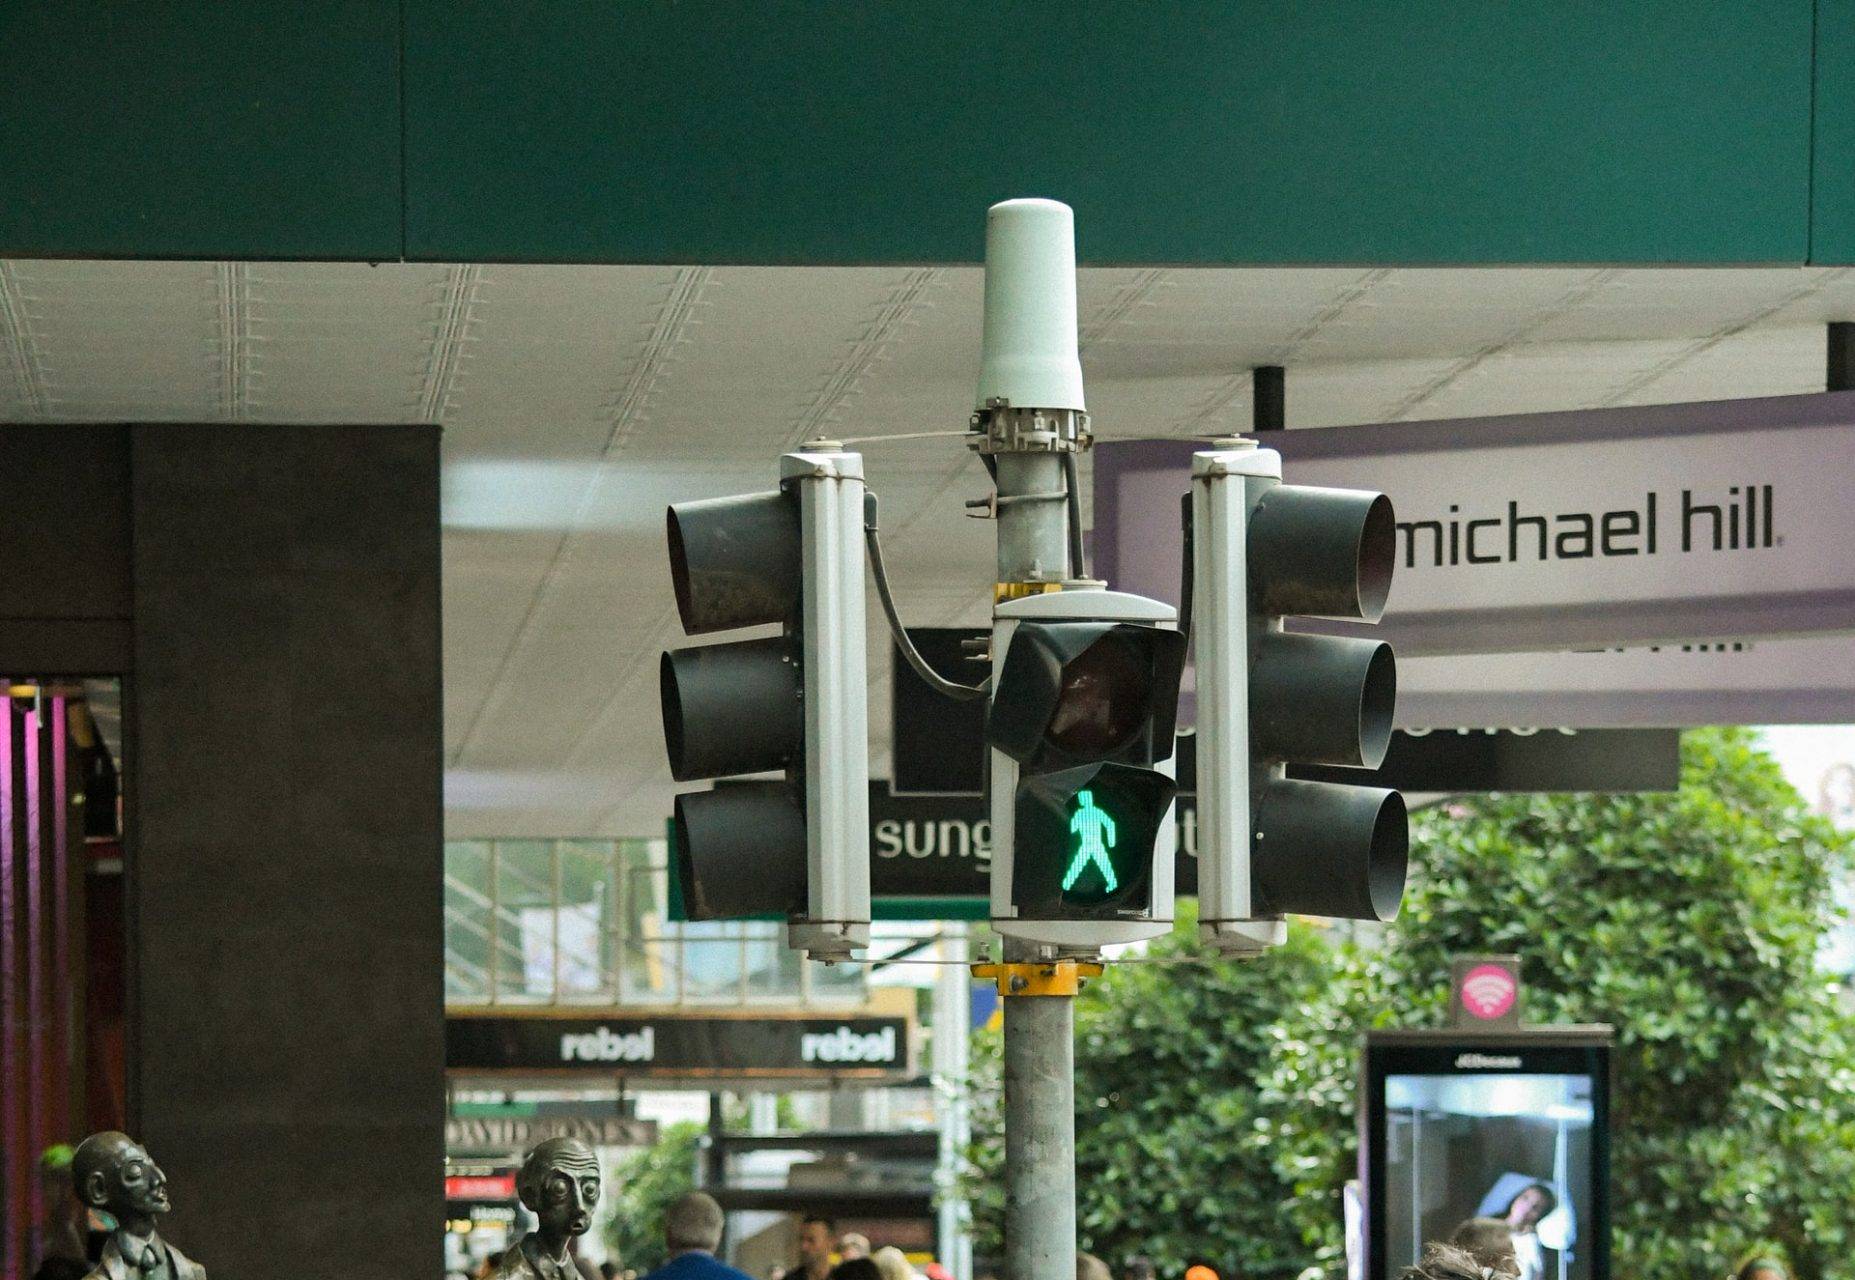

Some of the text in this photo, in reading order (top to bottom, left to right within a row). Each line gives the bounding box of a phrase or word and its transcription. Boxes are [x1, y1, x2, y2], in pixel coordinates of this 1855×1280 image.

[1396, 484, 1773, 568] michael hill
[561, 1025, 655, 1061] rebel
[801, 1025, 896, 1061] rebel
